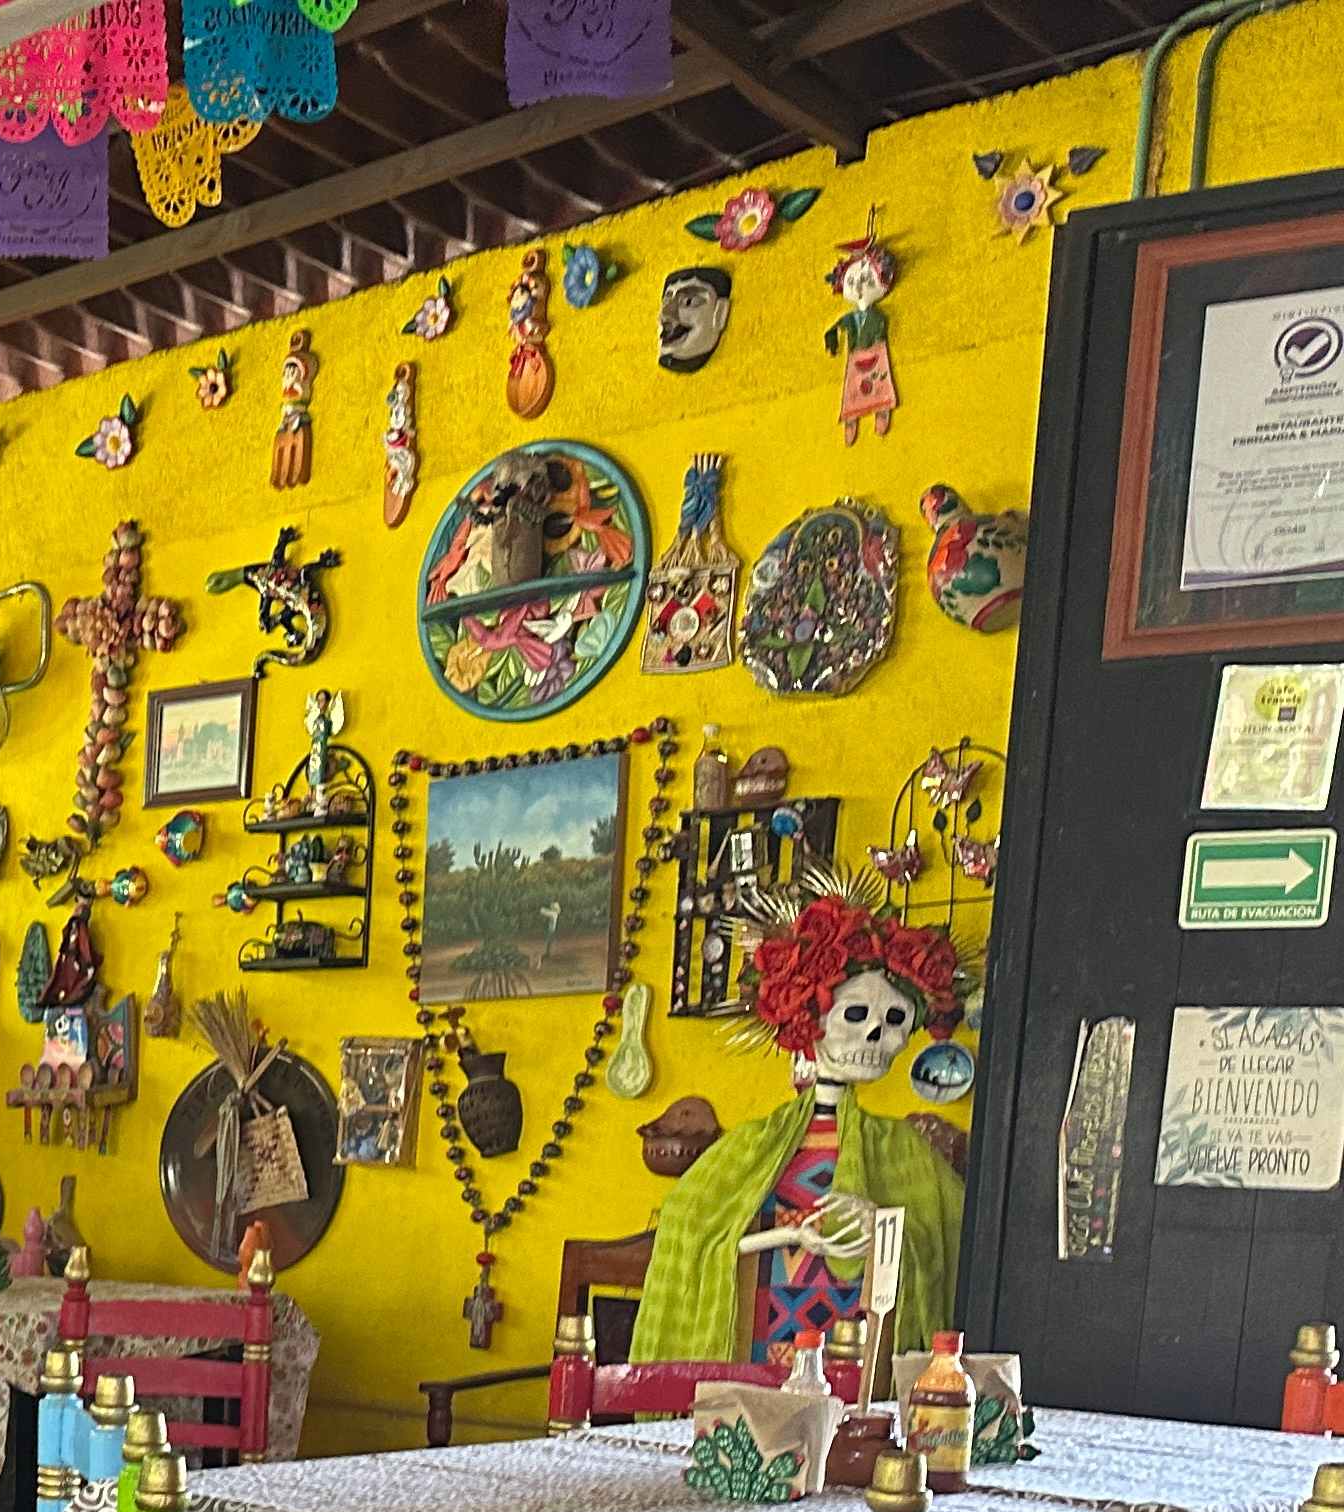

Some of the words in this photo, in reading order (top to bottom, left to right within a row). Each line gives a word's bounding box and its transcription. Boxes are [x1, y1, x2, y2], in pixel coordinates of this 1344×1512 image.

[1191, 906, 1219, 919] RUTA
[1223, 906, 1238, 920] DE
[1212, 1027, 1235, 1052] SI
[1238, 1024, 1321, 1056] ACABAS
[1219, 1056, 1235, 1075] DE
[1241, 1055, 1295, 1075] LLEGAR
[1191, 1078, 1319, 1118] BIENVENIDO
[1187, 1145, 1243, 1174] VUELVE
[1248, 1146, 1310, 1175] PRONTO
[877, 1215, 897, 1265] 11
